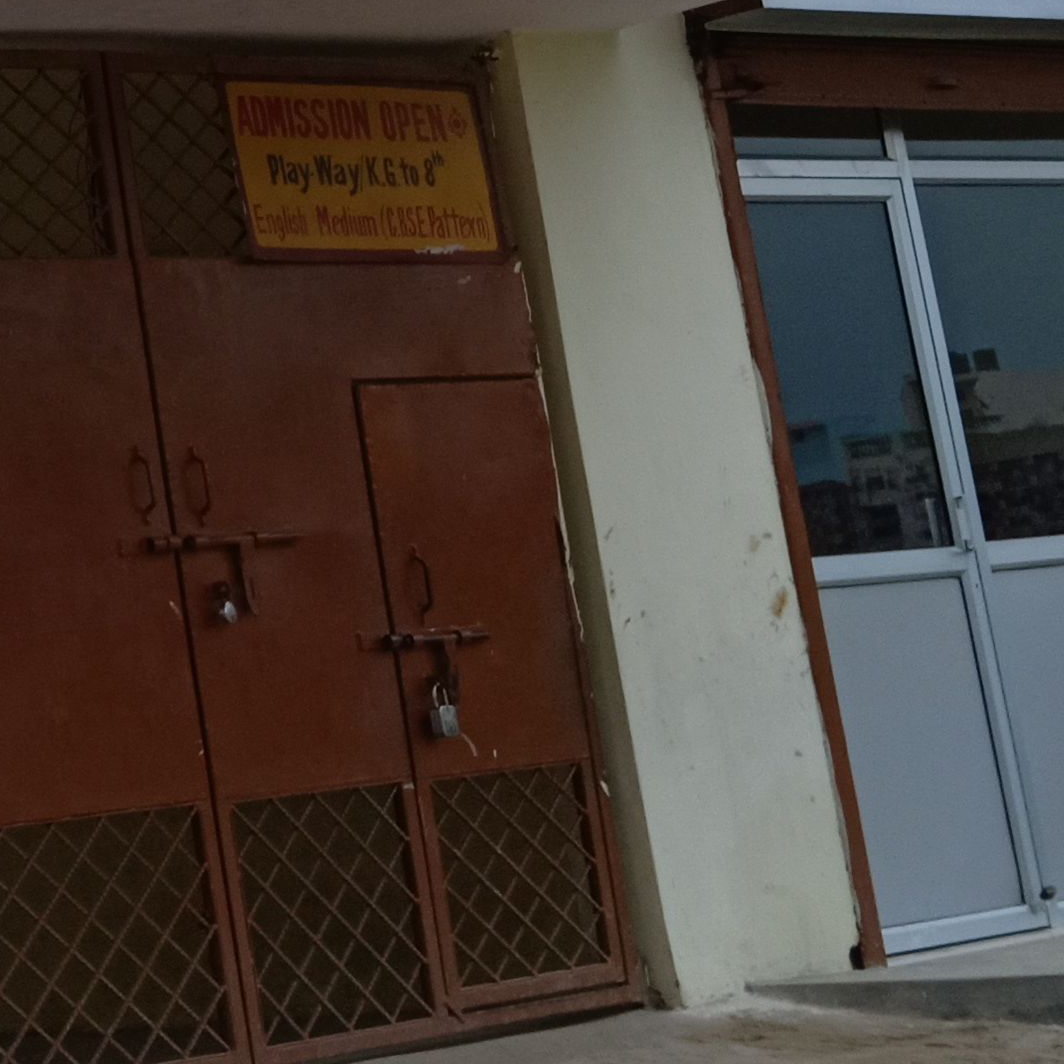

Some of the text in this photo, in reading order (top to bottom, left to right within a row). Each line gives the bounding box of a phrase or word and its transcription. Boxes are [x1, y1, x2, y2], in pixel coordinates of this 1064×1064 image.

[237, 95, 449, 142] ADMISSION OPEN
[400, 157, 420, 185] to
[253, 204, 308, 241] English
[315, 204, 378, 236] Medium
